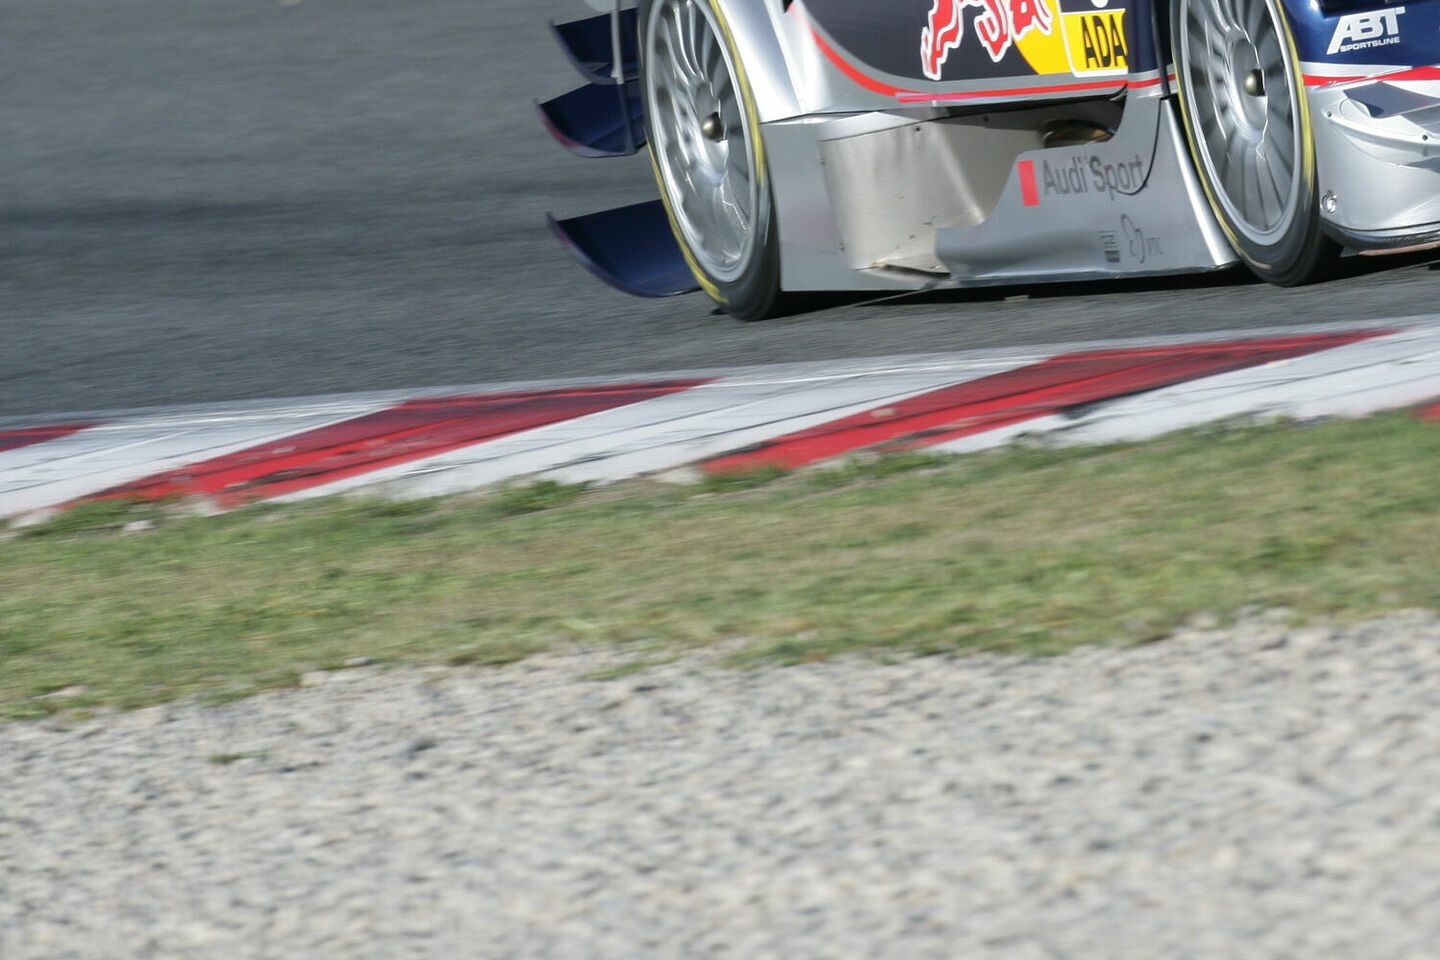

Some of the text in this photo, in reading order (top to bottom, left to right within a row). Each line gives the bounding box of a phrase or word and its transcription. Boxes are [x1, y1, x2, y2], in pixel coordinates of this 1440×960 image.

[1081, 12, 1129, 69] ADA
[1327, 6, 1406, 55] ABT
[1340, 36, 1400, 52] SPORTSLINE
[1043, 154, 1149, 201] Audi Sport
